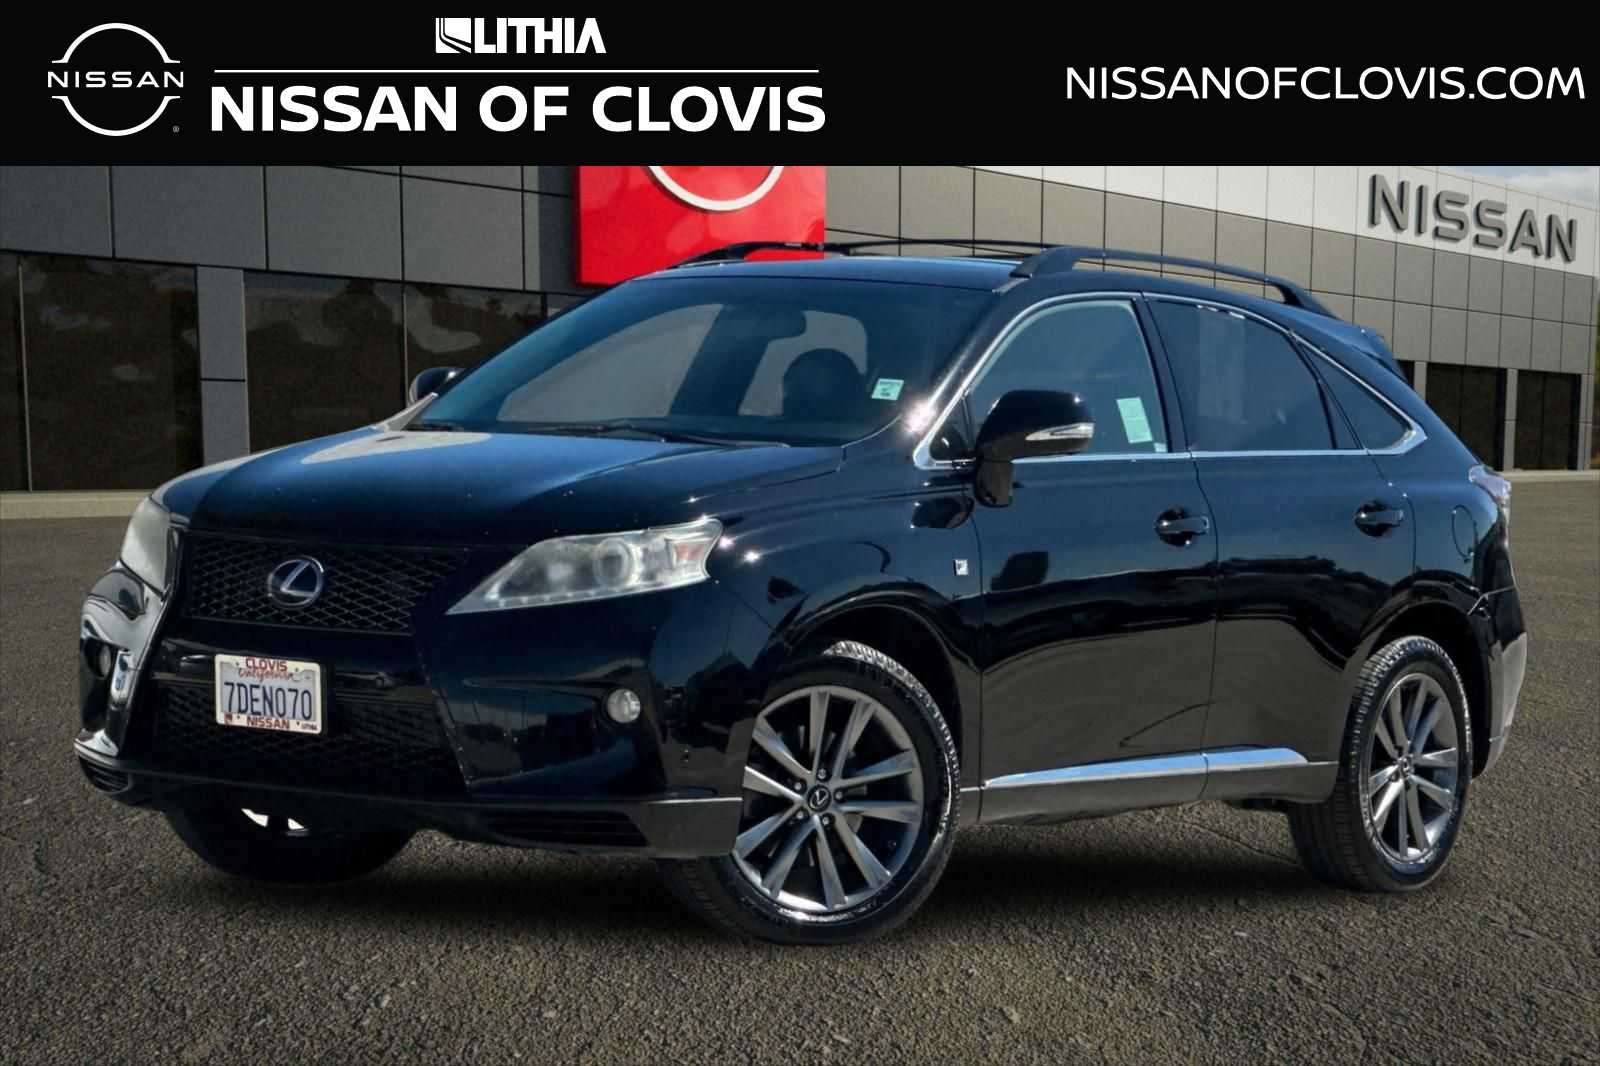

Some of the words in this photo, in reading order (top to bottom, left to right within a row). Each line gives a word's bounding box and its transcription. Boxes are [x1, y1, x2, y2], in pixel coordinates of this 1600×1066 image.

[1368, 174, 1577, 264] NISSAN
[245, 656, 288, 672] CLOVIS
[224, 682, 312, 720] 7DEN070
[246, 716, 290, 730] NISSAN
